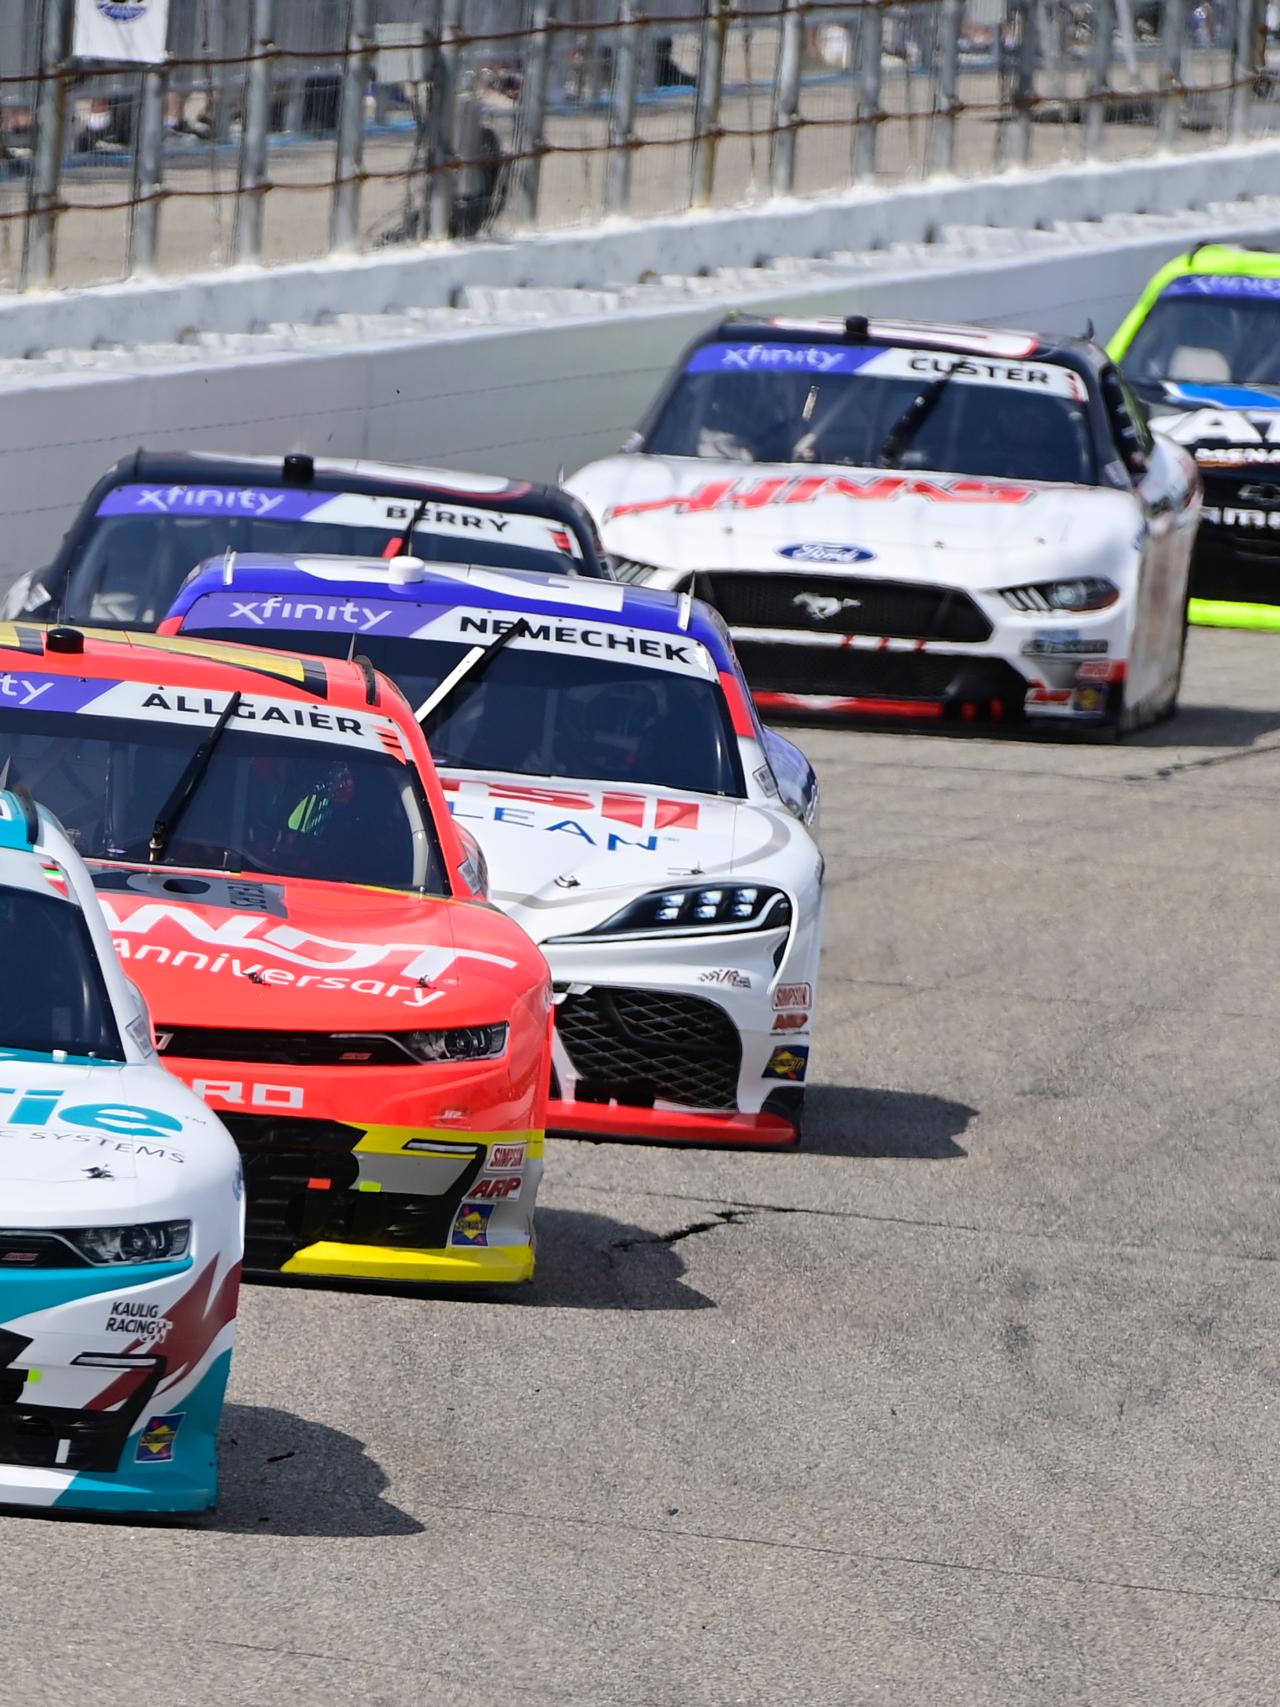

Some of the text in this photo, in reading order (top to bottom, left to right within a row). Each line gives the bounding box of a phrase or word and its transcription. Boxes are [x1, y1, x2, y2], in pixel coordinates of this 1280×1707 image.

[721, 344, 845, 369] xfinity
[908, 356, 1049, 383] CUSTER
[135, 486, 285, 515] xfinity
[385, 505, 510, 532] BERRY
[228, 598, 393, 631] xfinity
[460, 616, 691, 664] NEMECHEK
[141, 693, 363, 736] ALLGAIER
[191, 1078, 304, 1109] RO
[29, 1130, 186, 1164] SYSTEMS
[468, 1176, 522, 1199] ARP
[110, 1301, 159, 1319] KAULIG
[105, 1317, 157, 1335] RACING
